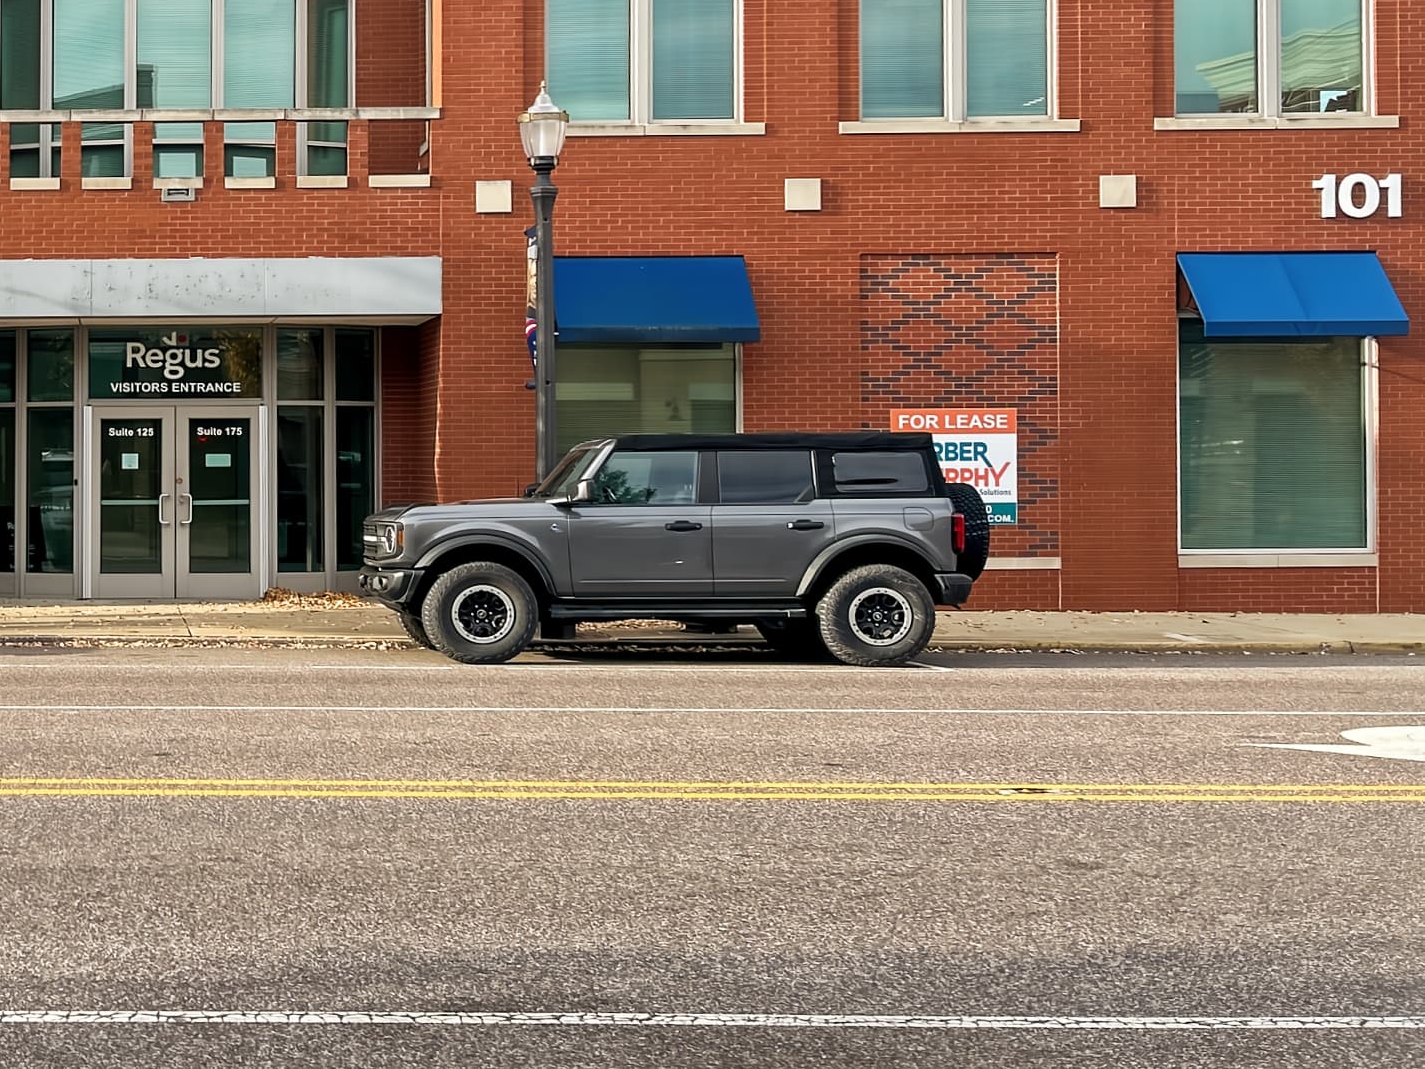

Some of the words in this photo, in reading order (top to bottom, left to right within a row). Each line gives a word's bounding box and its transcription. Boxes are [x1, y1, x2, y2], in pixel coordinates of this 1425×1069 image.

[1311, 172, 1403, 219] 101
[126, 342, 221, 379] Regus
[110, 382, 169, 393] VISITORS
[171, 382, 242, 393] ENTRANCE
[898, 414, 939, 429] FOR
[944, 414, 1008, 429] LEASE
[108, 427, 134, 437] Suite
[136, 427, 154, 437] 125
[196, 426, 223, 436] Suite
[225, 426, 243, 436] 175
[933, 441, 993, 468] RBER
[941, 461, 1011, 487] RPHY
[979, 488, 1012, 496] Solutions
